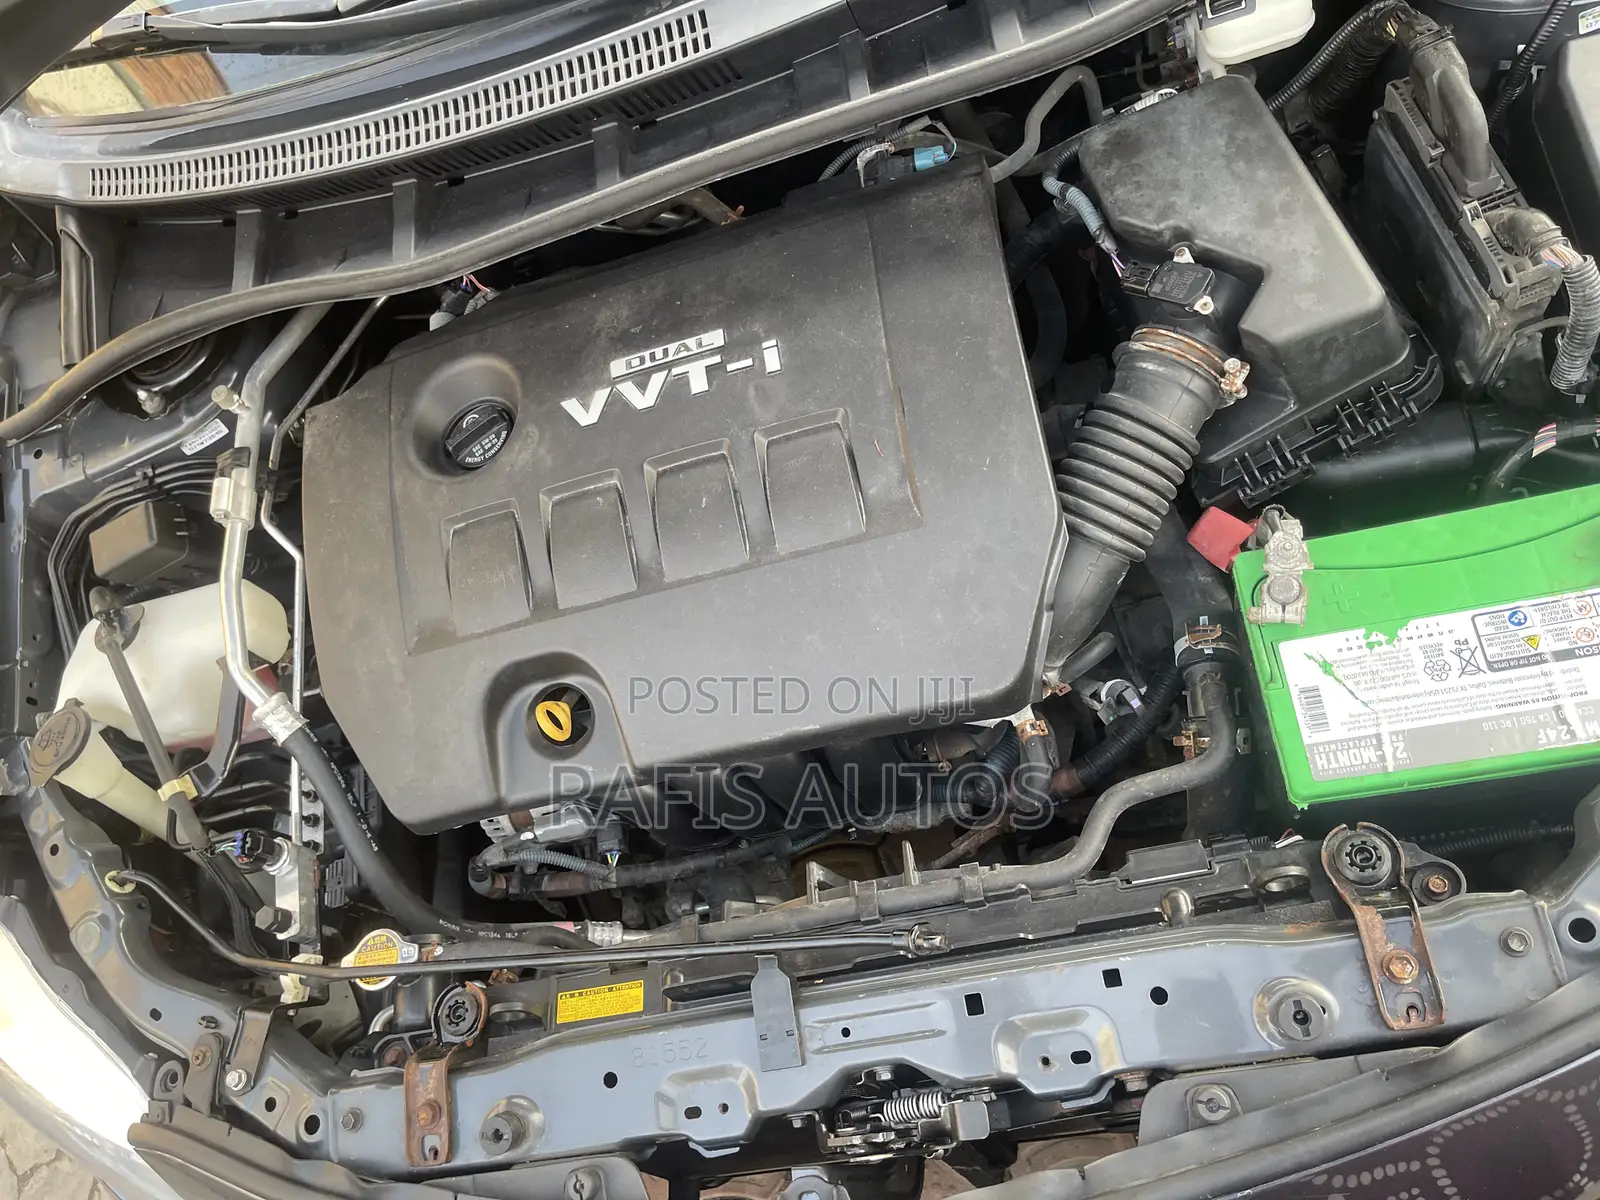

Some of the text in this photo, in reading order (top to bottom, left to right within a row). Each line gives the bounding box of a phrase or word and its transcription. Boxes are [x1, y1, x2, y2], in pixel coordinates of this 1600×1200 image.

[626, 337, 714, 370] DUAL
[560, 339, 783, 427] VVT-i
[485, 431, 507, 458] CONSERVING
[1453, 638, 1469, 646] Pb
[1537, 712, 1549, 721] CA
[1482, 720, 1497, 730] 110
[1498, 718, 1511, 728] RC
[1312, 736, 1376, 753] REPLACEMENT
[361, 942, 392, 952] CAUTION
[582, 987, 608, 996] CAUTION
[612, 982, 641, 991] ATTENTION
